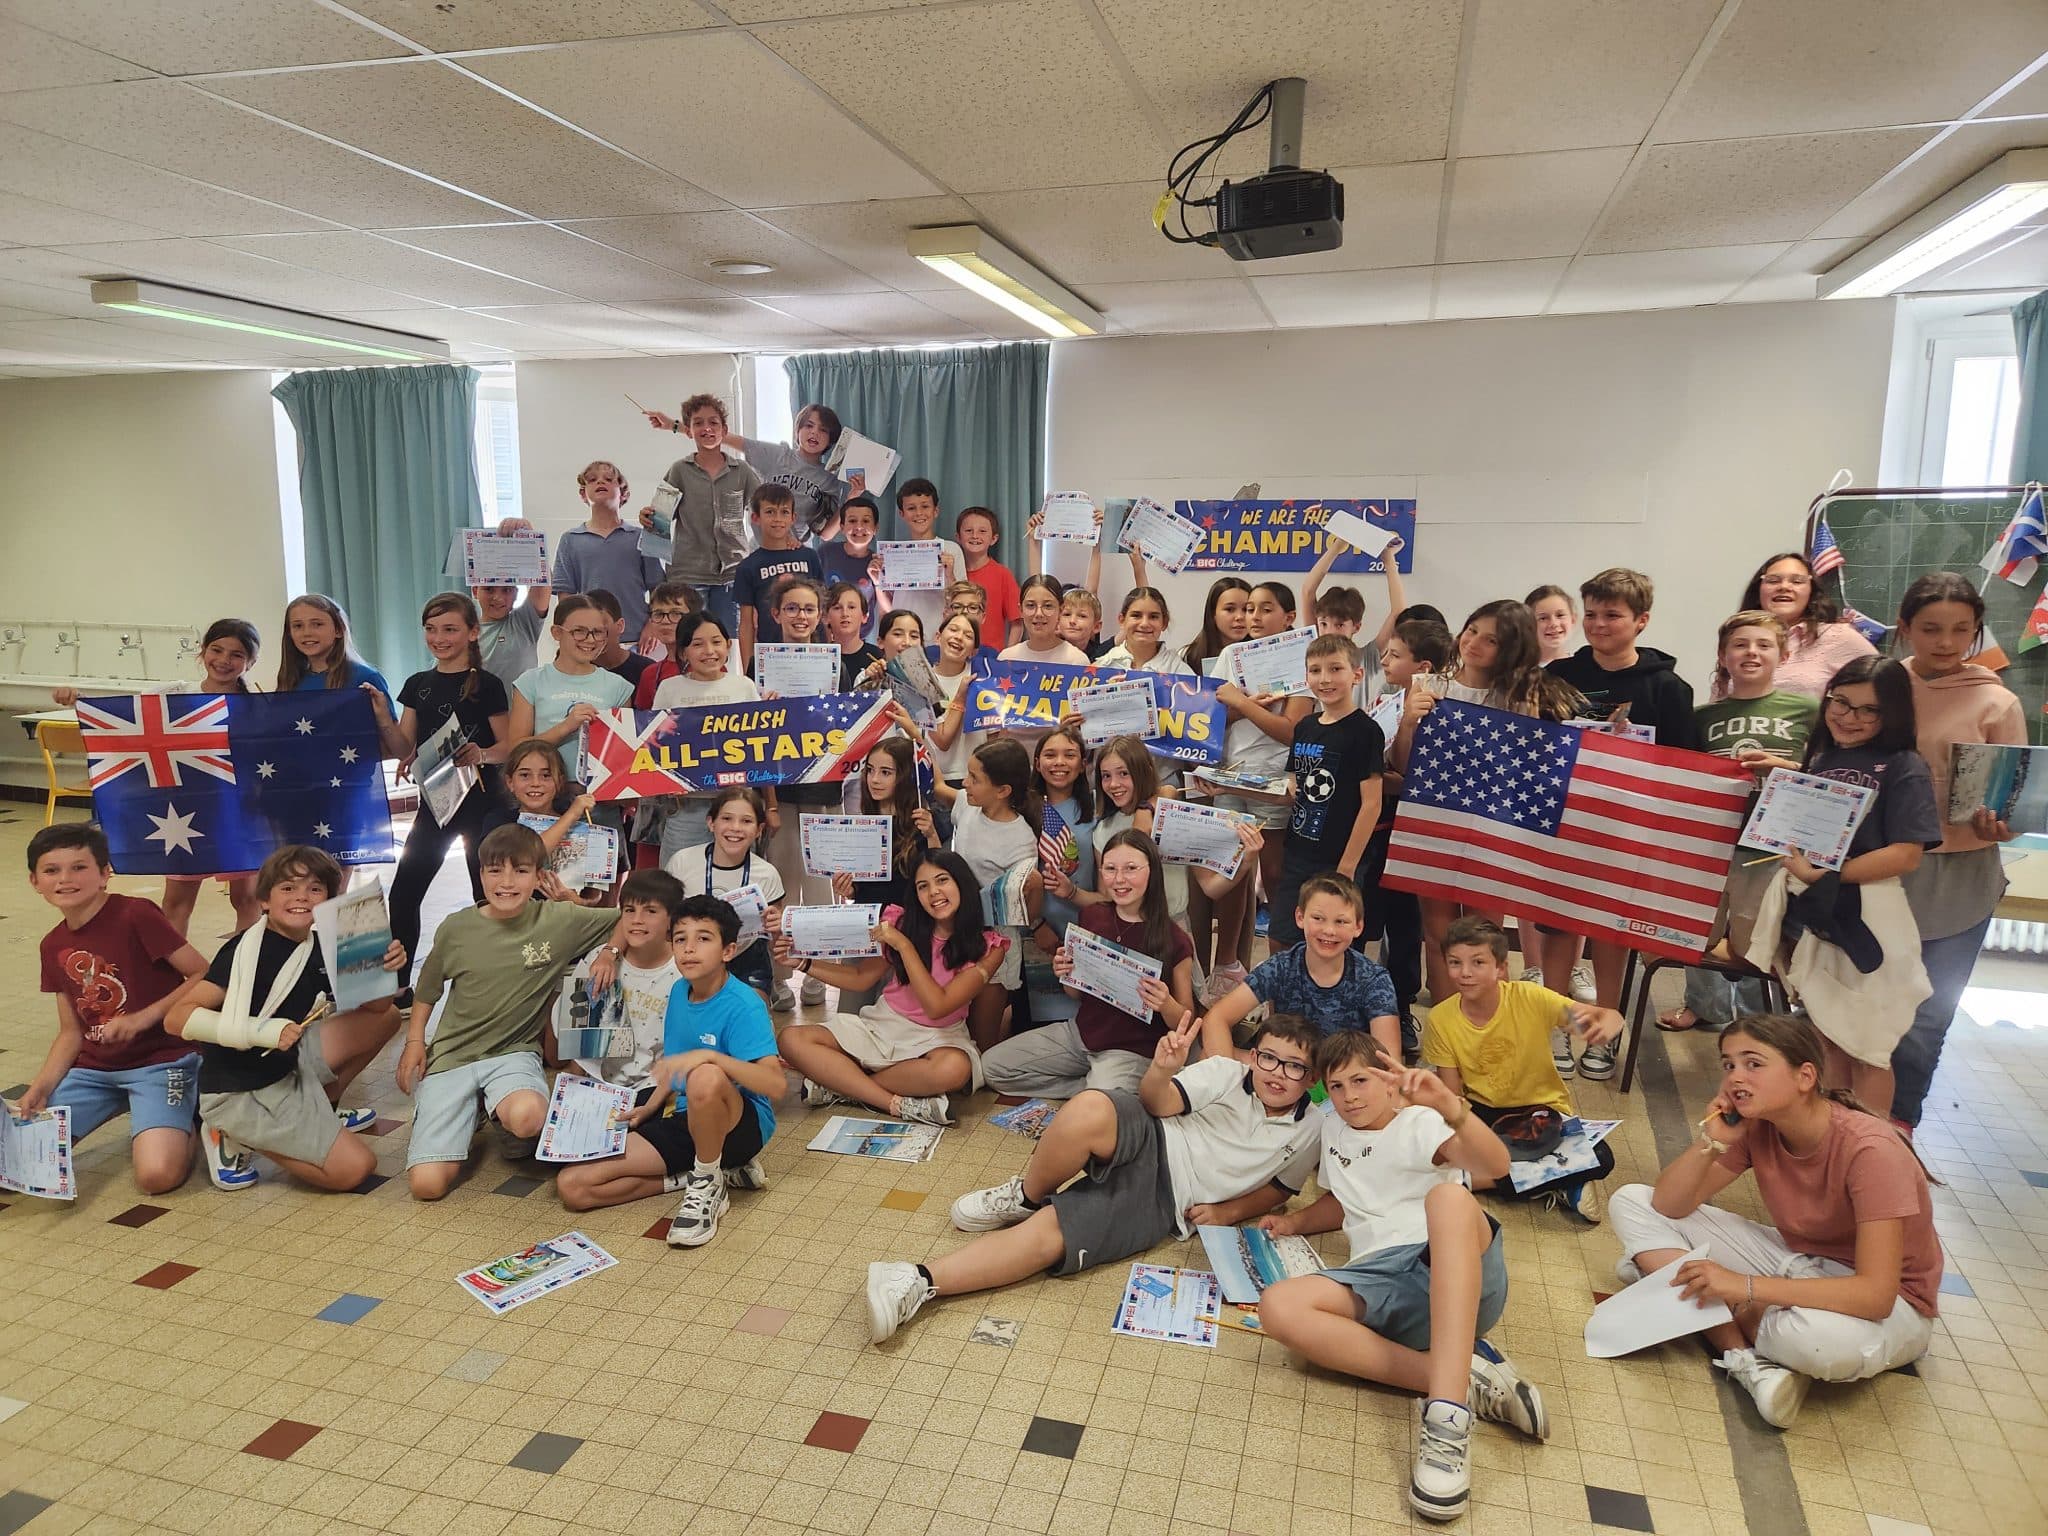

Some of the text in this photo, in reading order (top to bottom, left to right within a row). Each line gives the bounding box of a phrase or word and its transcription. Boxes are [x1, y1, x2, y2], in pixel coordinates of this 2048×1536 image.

[772, 474, 803, 491] NEW
[1240, 507, 1331, 526] WE ARE THE
[1194, 529, 1362, 555] CHAMPIO
[759, 560, 809, 580] BOSTON
[1196, 558, 1217, 569] BIG
[1368, 560, 1400, 572] 20
[1039, 673, 1064, 692] WE
[1069, 675, 1101, 691] ARE
[701, 708, 787, 735] ENGLISH
[976, 689, 1211, 741] CHANS
[983, 715, 1002, 726] BIG
[1707, 715, 1794, 742] CORK
[629, 728, 848, 775] ALL-STARS
[1172, 746, 1208, 761] 2026
[1294, 742, 1325, 758] GAME
[702, 769, 793, 785] the BIG Challenge
[342, 851, 359, 859] BIG
[1630, 922, 1656, 936] BIG
[1361, 1145, 1373, 1158] UP
